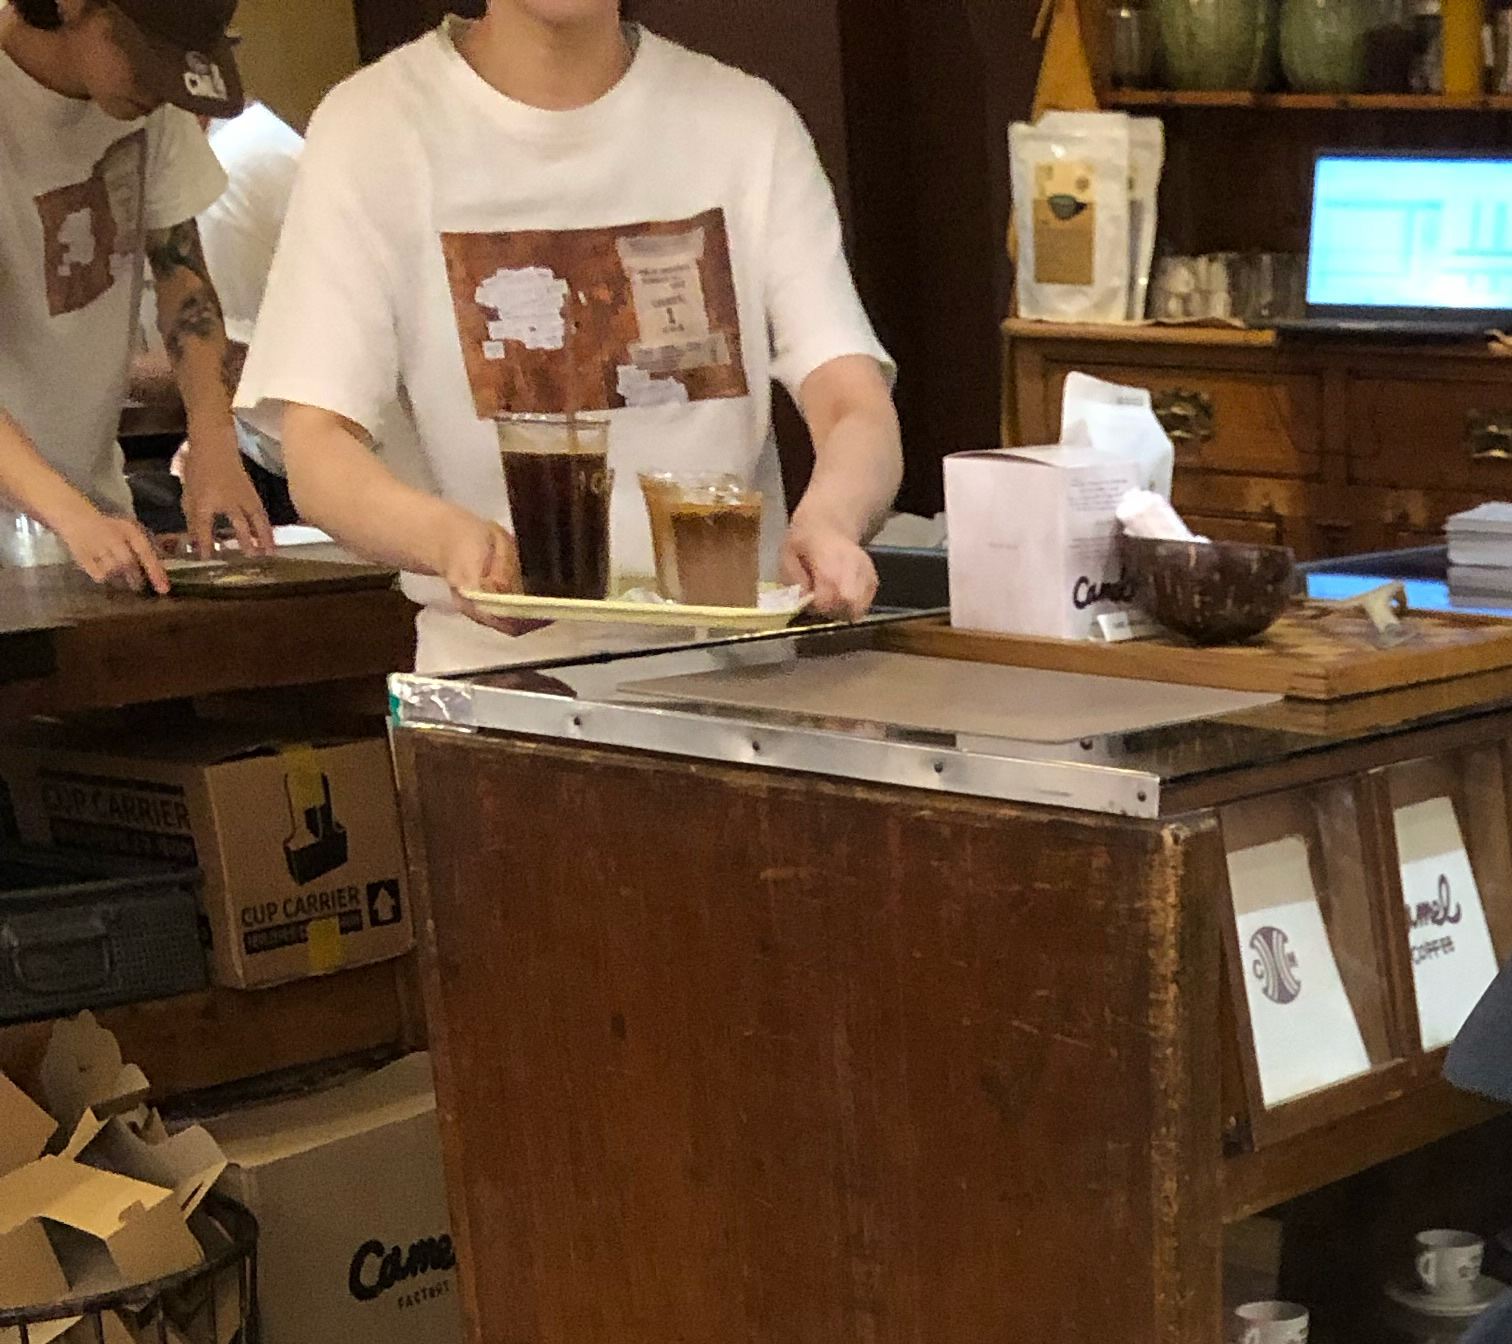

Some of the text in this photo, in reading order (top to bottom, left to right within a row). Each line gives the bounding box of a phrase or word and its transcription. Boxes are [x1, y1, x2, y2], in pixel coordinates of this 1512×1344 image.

[241, 885, 361, 927] CUP CARRIER
[348, 1233, 457, 1302] Came
